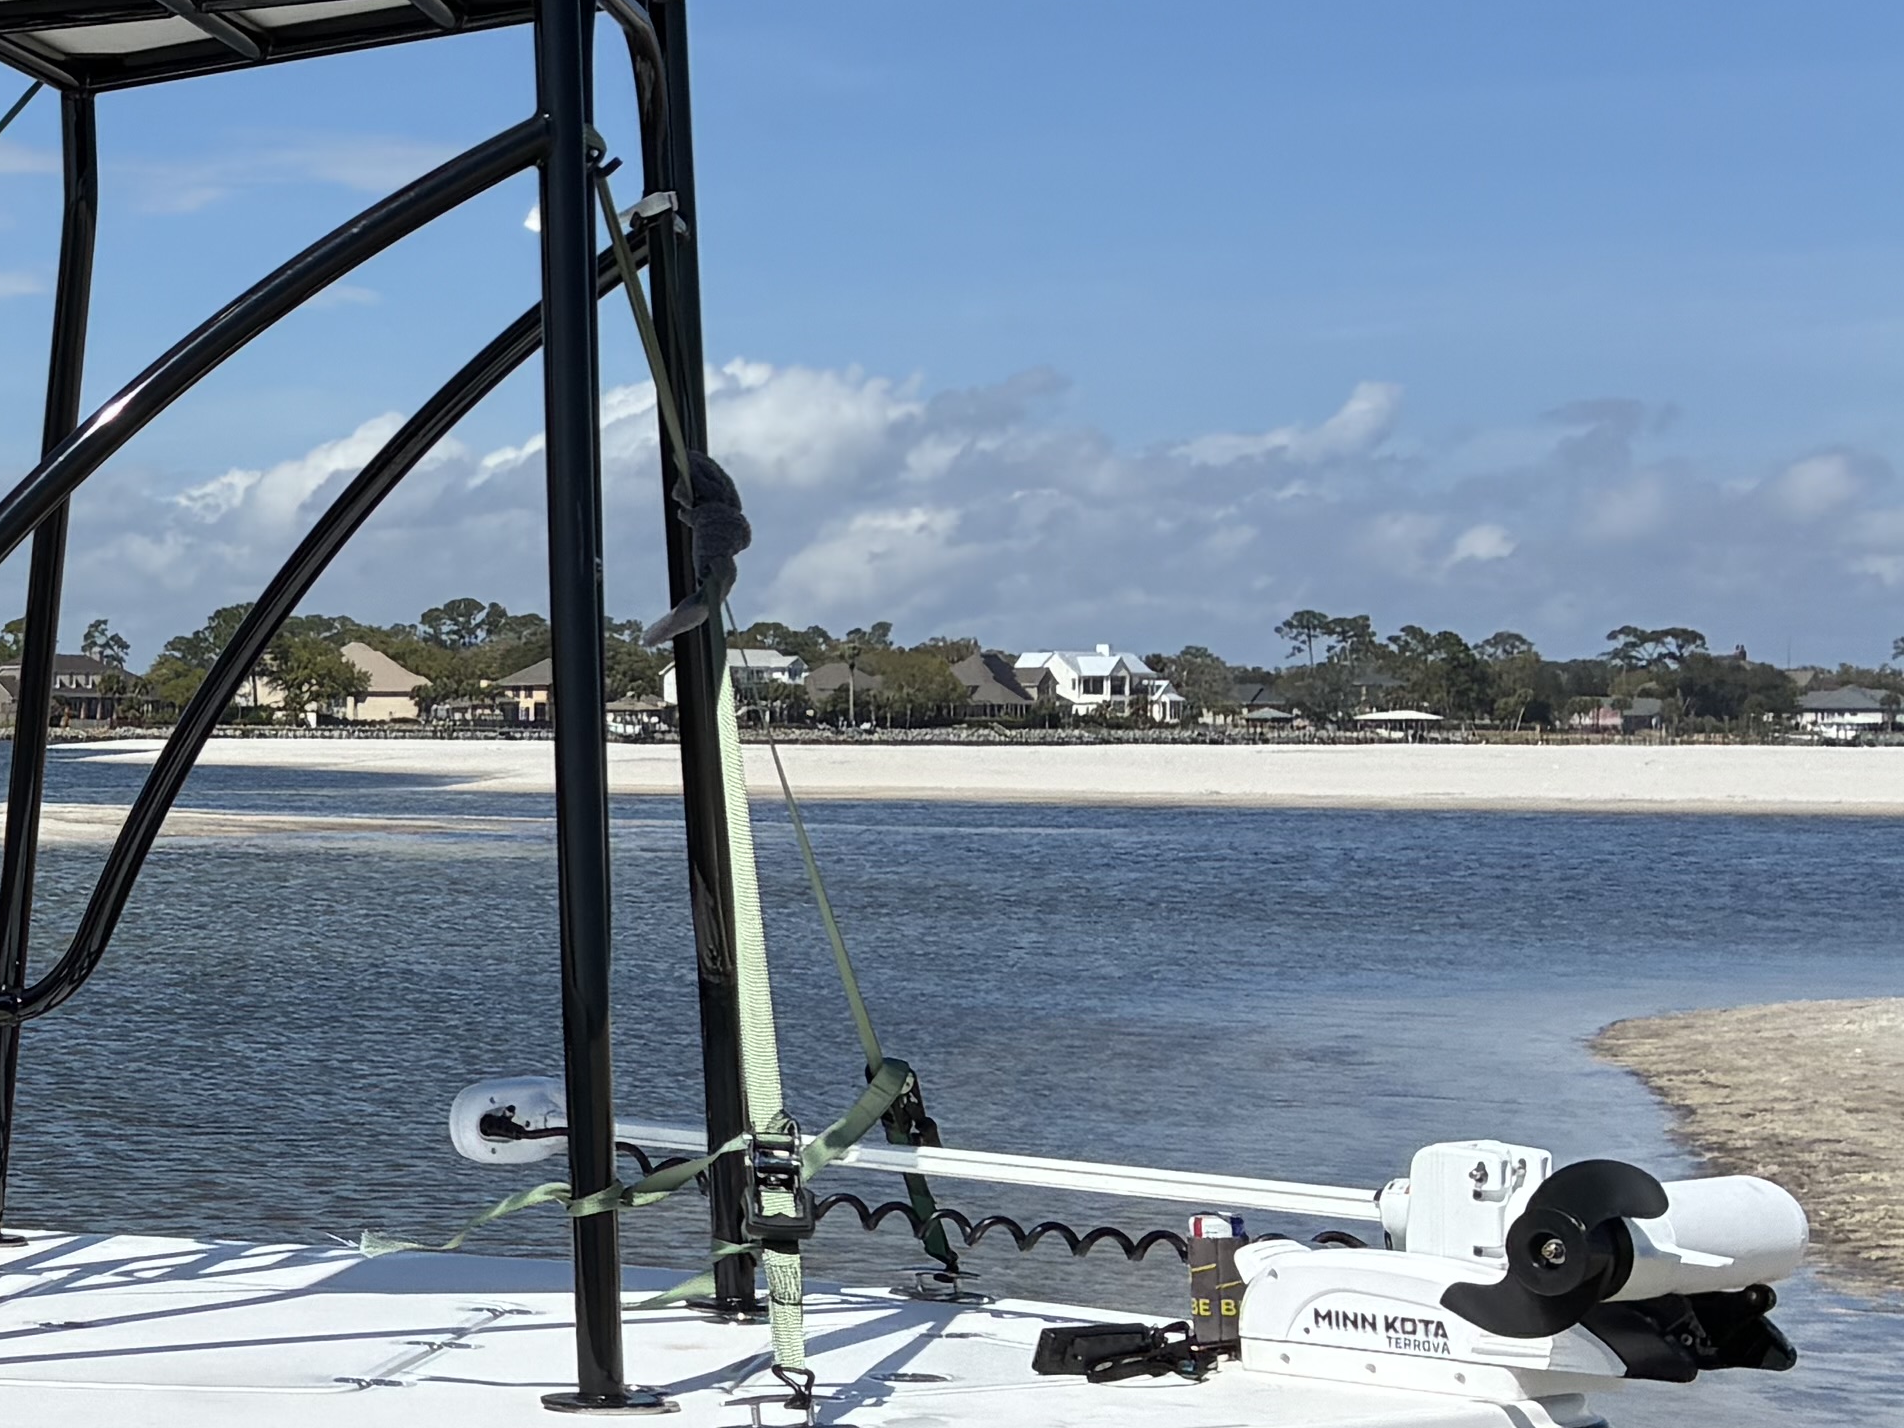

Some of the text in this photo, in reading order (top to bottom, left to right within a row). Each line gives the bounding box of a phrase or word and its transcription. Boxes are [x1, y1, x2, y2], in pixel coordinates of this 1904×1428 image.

[1313, 1307, 1449, 1340] MINN KOTA
[1386, 1335, 1451, 1355] TERROVA
